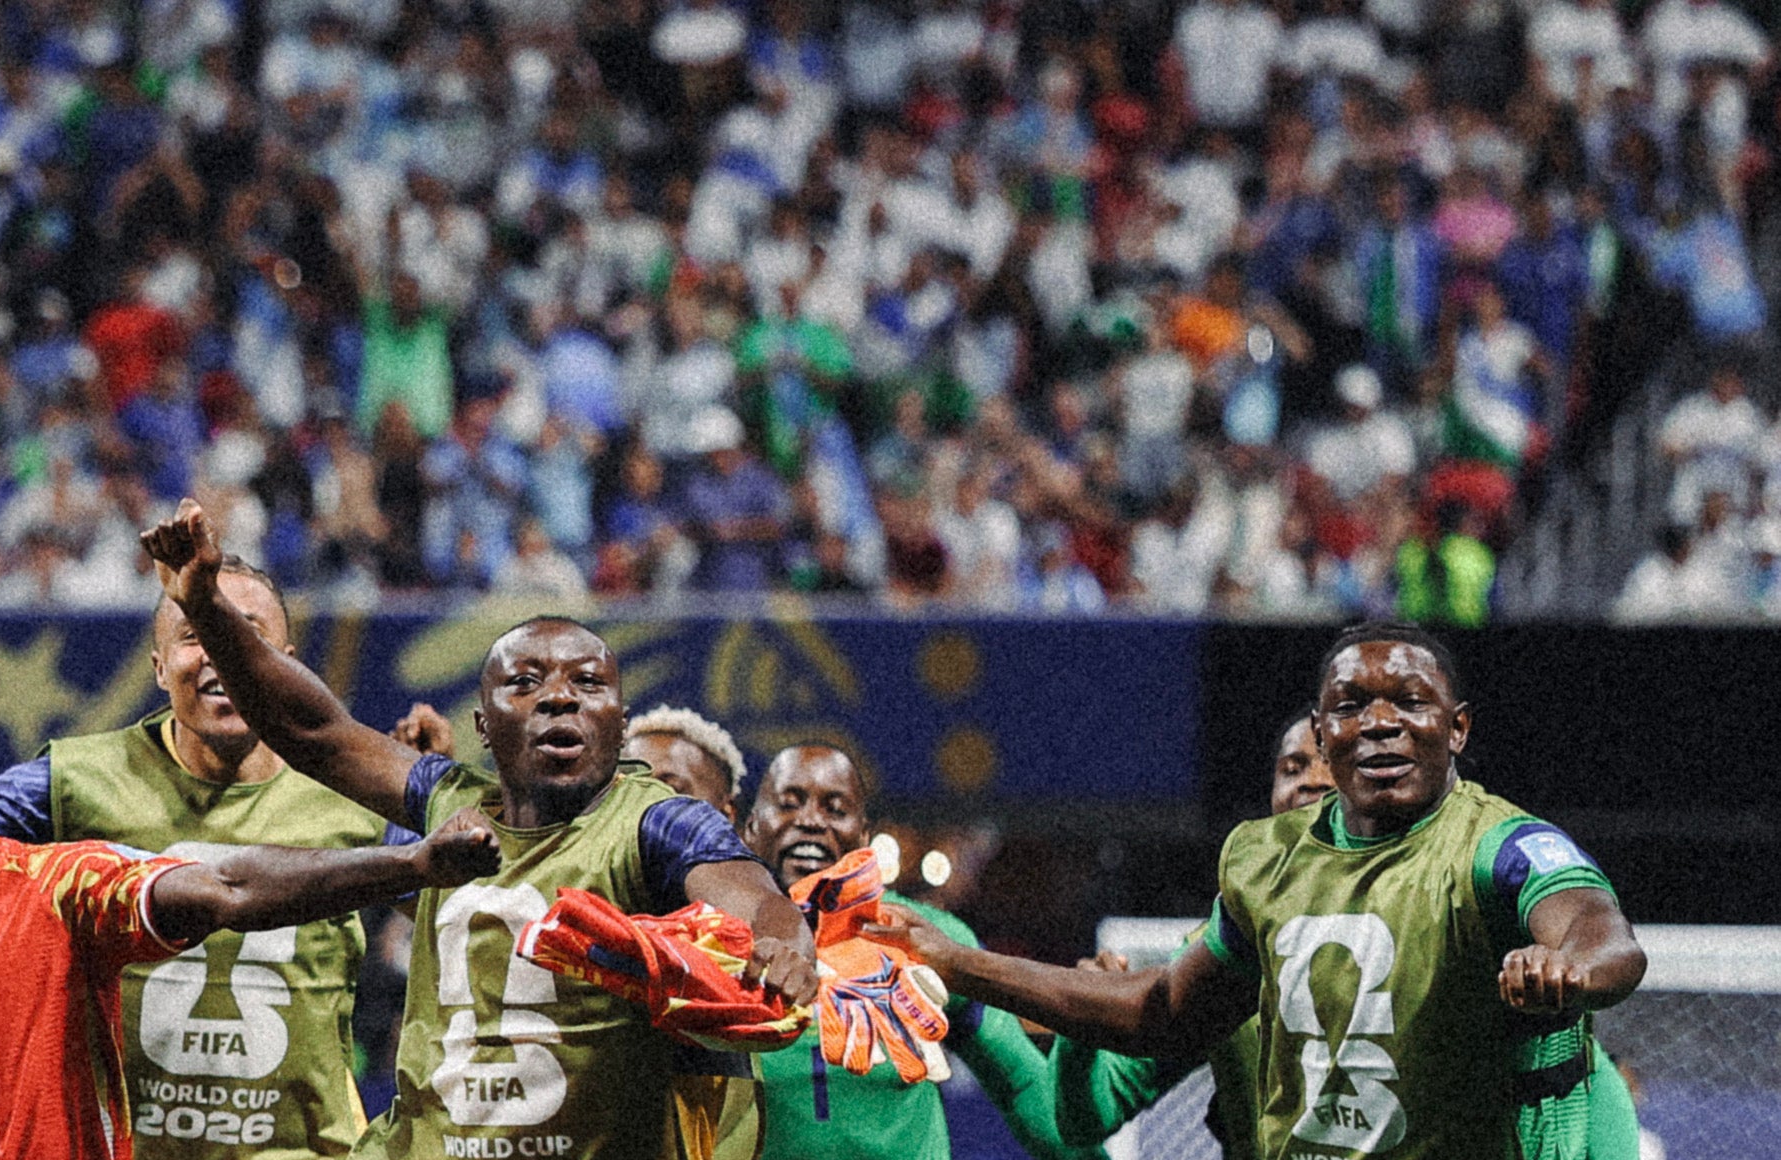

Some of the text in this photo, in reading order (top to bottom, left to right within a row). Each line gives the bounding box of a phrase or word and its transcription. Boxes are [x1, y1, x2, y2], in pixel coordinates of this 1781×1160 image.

[182, 1032, 247, 1056] FIFA
[139, 1078, 281, 1109] WORLD CUP
[464, 1077, 526, 1102] FIFA
[136, 1103, 275, 1145] 2026
[1313, 1102, 1372, 1131] FIFA
[444, 1135, 573, 1159] WORLD CUP
